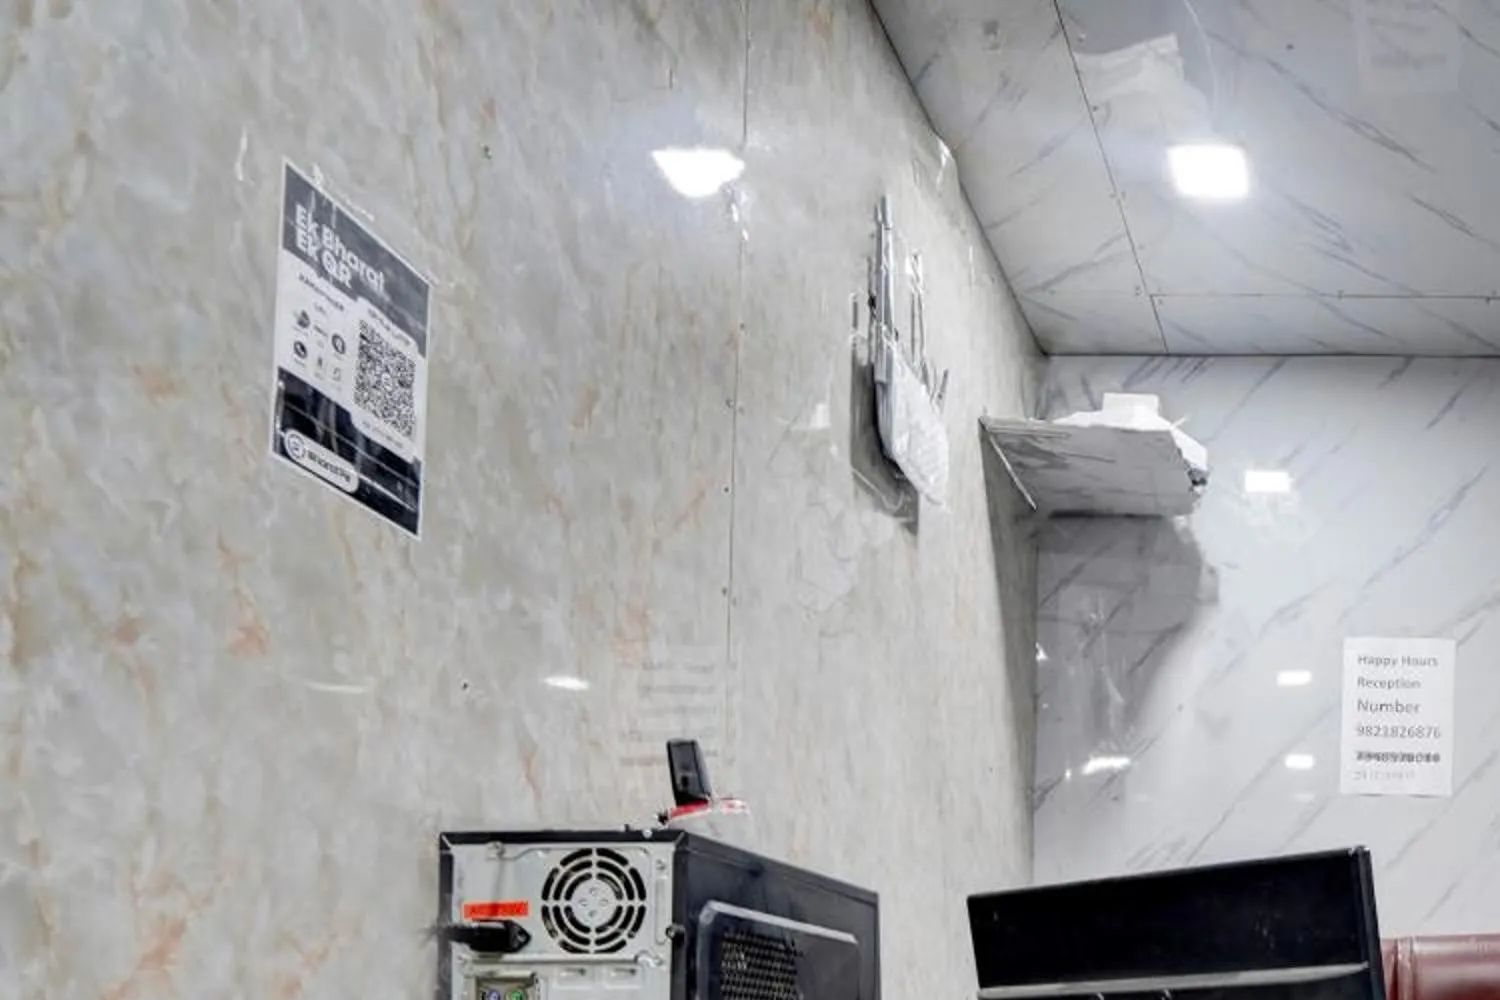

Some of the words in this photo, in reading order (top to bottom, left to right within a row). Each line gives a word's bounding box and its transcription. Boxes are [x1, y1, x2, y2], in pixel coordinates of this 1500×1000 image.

[296, 203, 320, 243] Ek
[321, 222, 385, 294] Bharat
[295, 228, 318, 262] Ek
[321, 249, 352, 289] QR
[1357, 655, 1398, 668] Happy
[1401, 655, 1439, 668] Hours
[1357, 676, 1422, 690] Reception
[1357, 699, 1421, 714] Number
